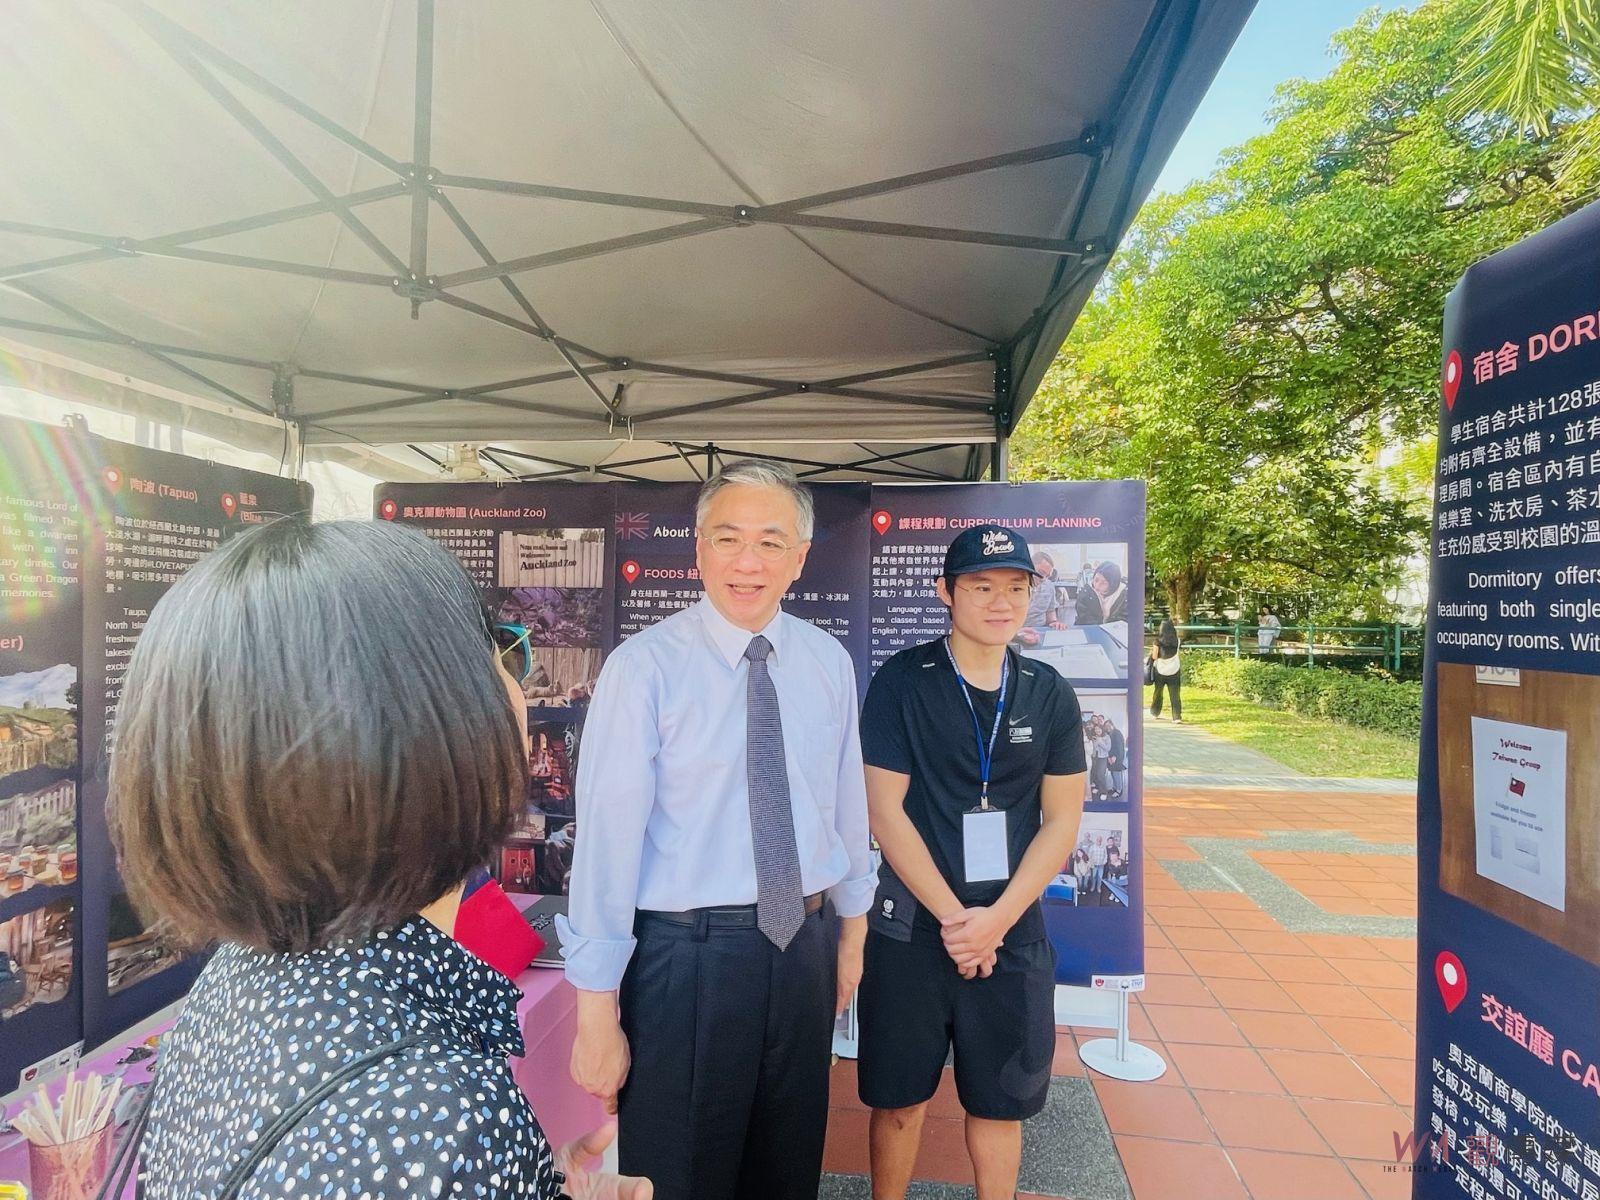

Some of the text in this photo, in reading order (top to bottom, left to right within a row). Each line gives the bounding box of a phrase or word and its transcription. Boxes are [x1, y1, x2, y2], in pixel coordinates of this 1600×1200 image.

[1472, 311, 1600, 385] 宿舍 DOR
[469, 507, 520, 519] (Auckland
[523, 507, 547, 519] Zoo)
[899, 517, 946, 529] 課程規劃
[1036, 517, 1102, 528] PLANNING
[653, 526, 691, 538] About
[644, 568, 702, 580] FOODS 紐
[1468, 569, 1542, 591] Dormitory
[887, 606, 922, 614] Language
[1437, 598, 1600, 623] featuring both single
[105, 621, 128, 630] North
[922, 616, 945, 624] based
[872, 627, 898, 636] English
[901, 627, 946, 636] performance
[1437, 631, 1503, 651] occupancy
[1507, 633, 1564, 651] rooms.
[1480, 992, 1555, 1066] 交誼廳
